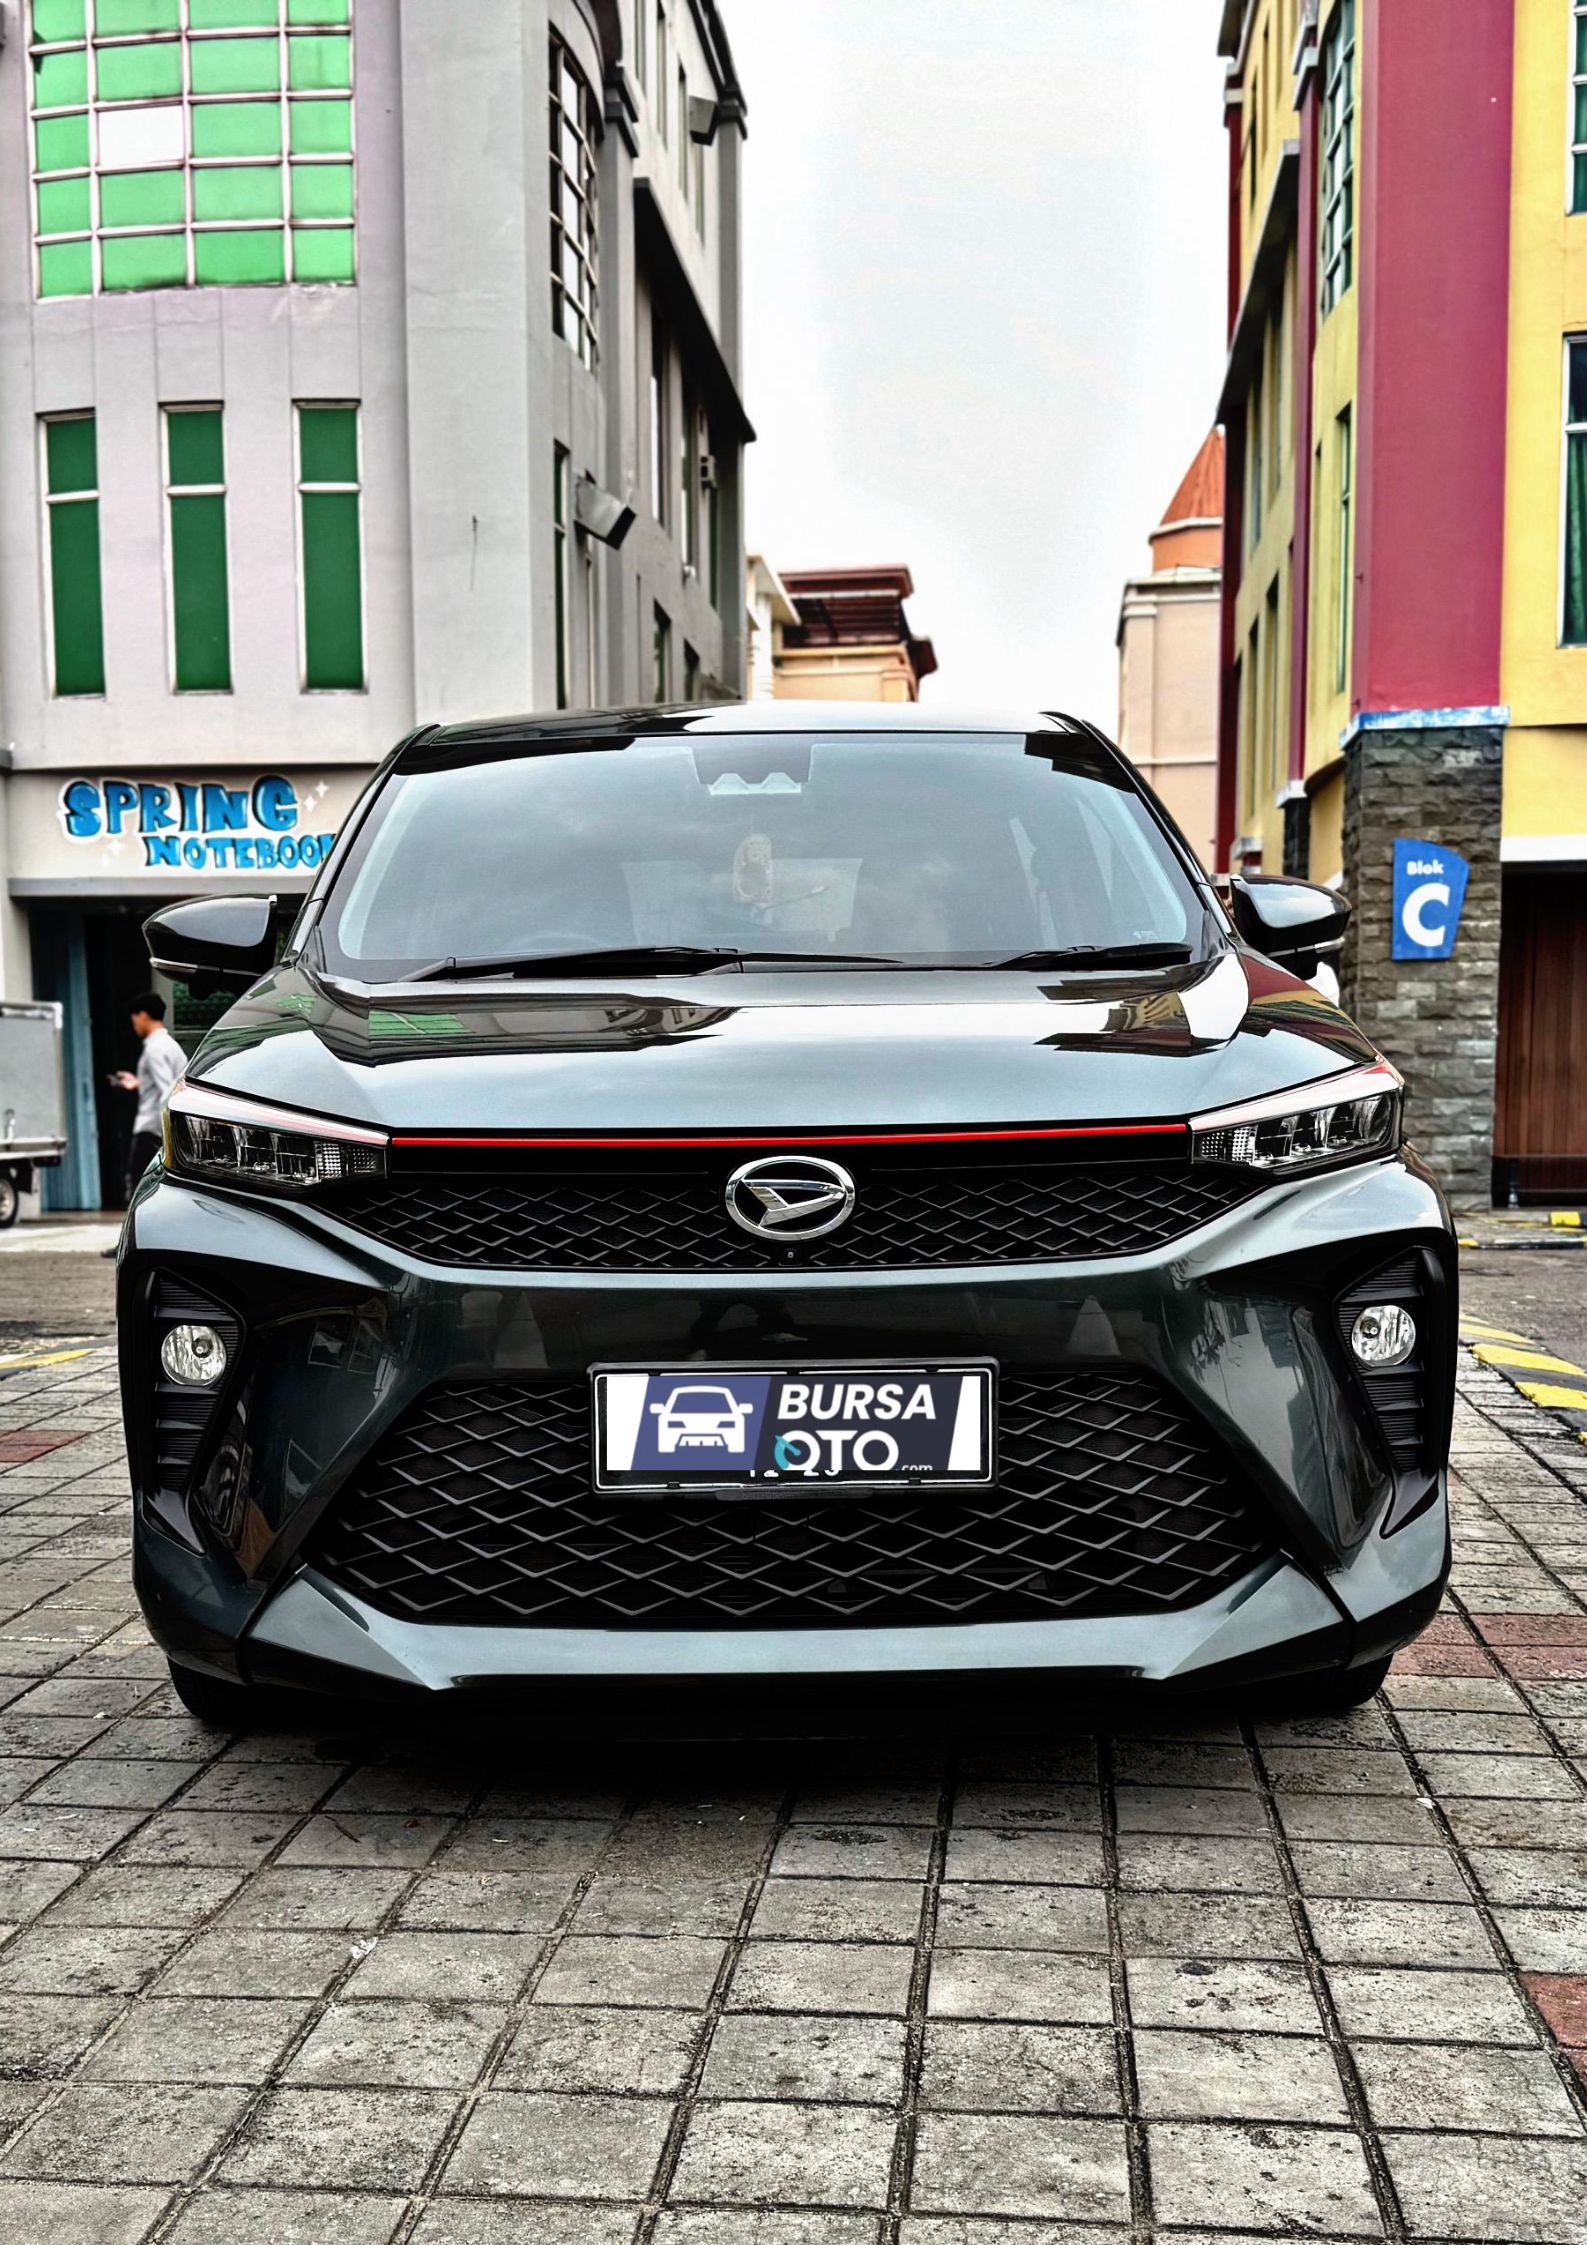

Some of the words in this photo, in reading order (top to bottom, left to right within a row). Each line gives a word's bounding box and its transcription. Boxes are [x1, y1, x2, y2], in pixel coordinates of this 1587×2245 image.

[63, 775, 298, 836] SPRING
[1406, 859, 1444, 875] Blok
[1402, 882, 1450, 947] C
